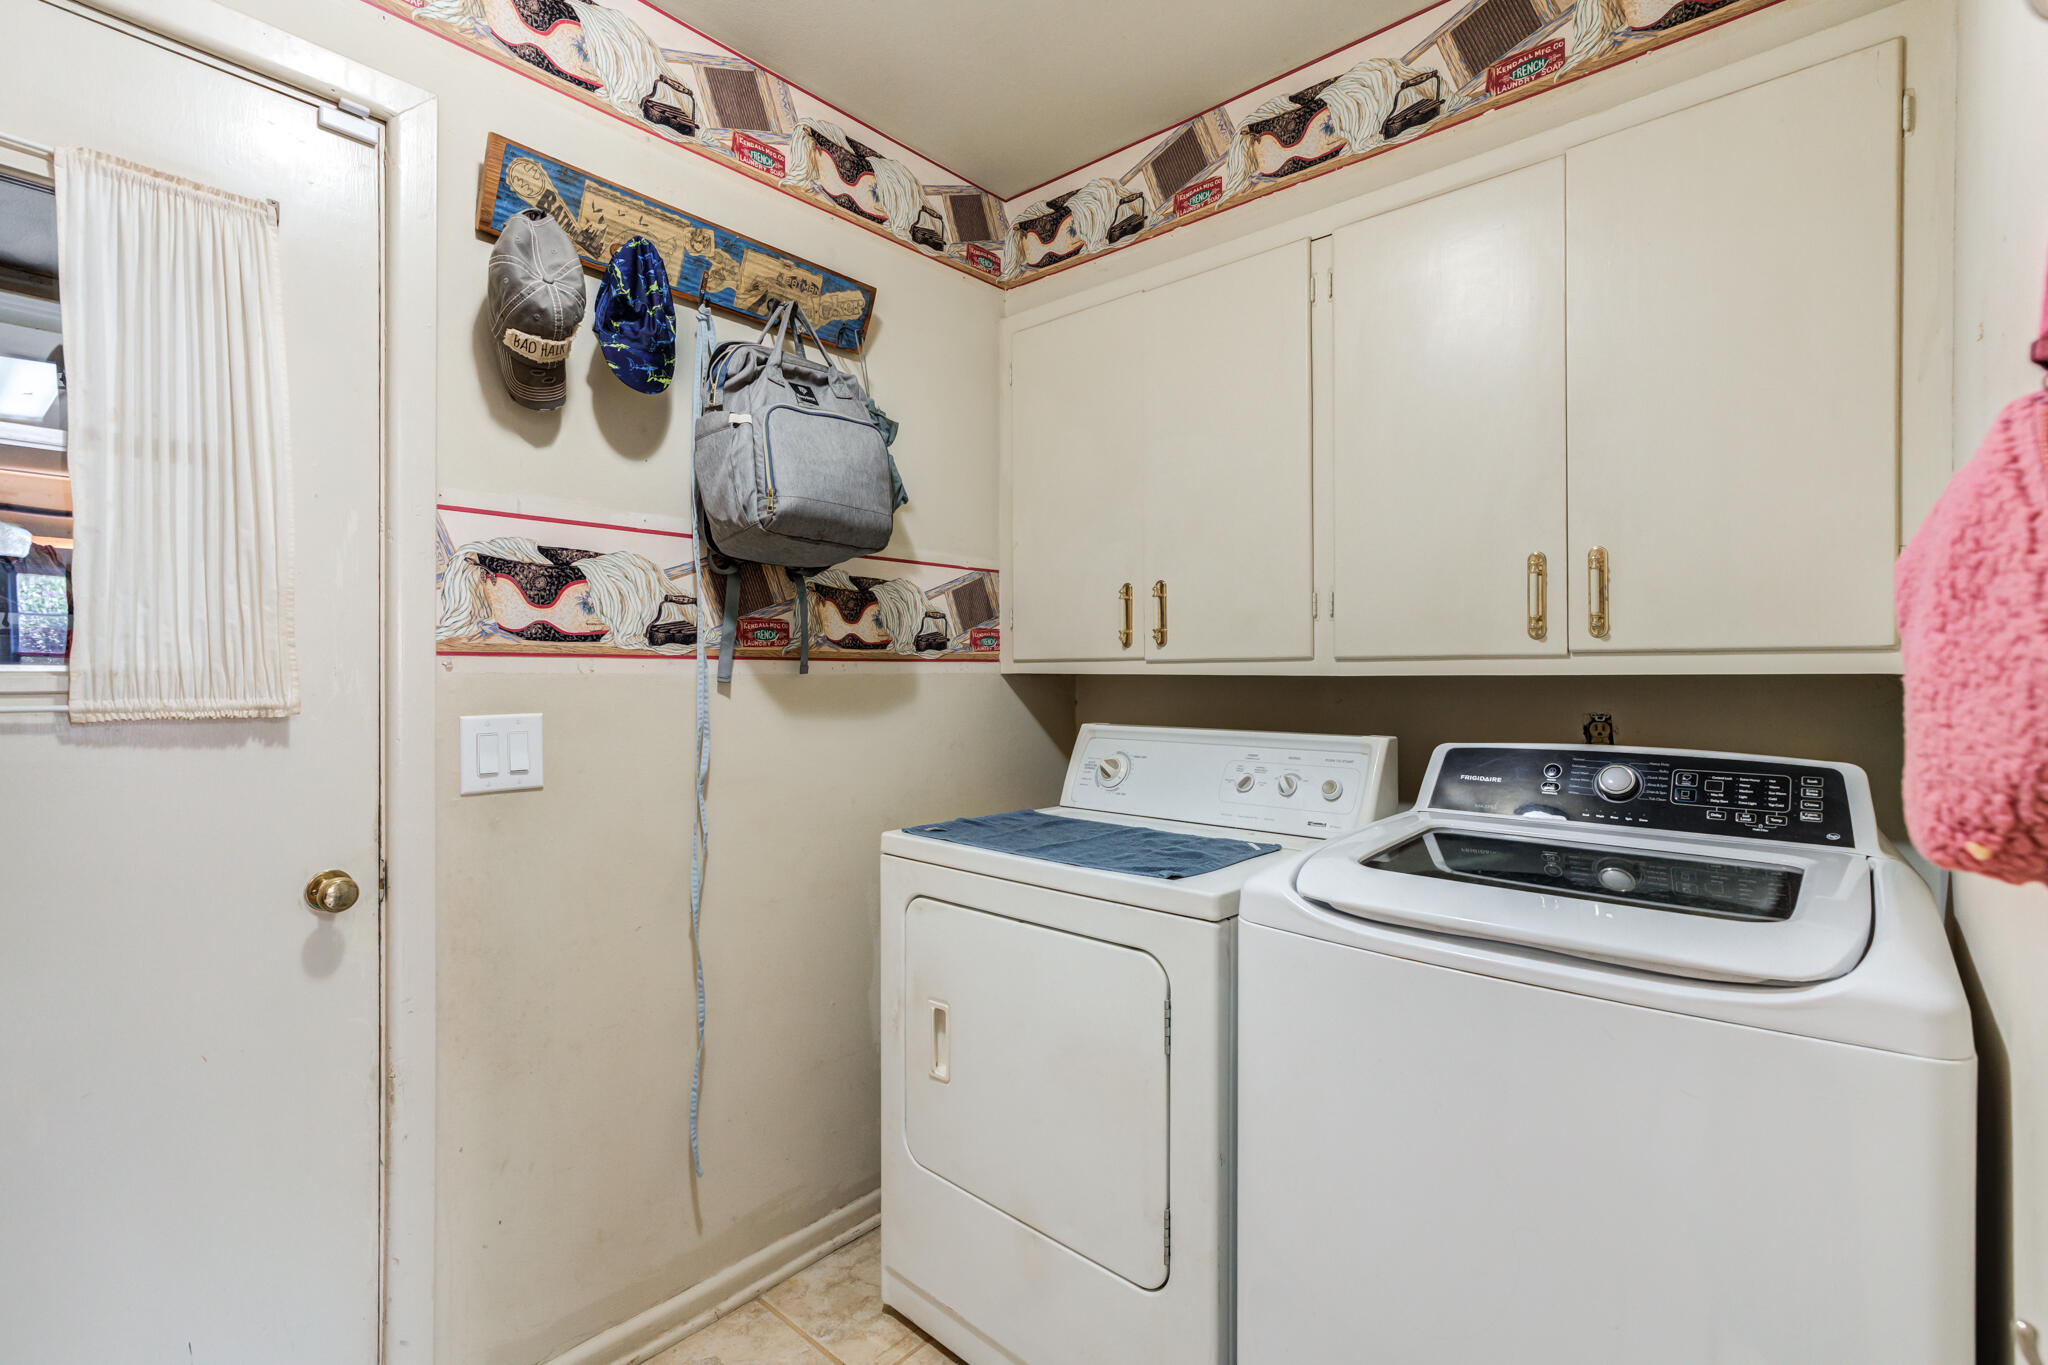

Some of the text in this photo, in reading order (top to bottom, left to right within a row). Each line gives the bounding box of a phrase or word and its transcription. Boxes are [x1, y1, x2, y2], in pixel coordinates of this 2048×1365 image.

[1496, 54, 1534, 75] KENDALL
[1553, 41, 1564, 50] CO
[1512, 58, 1545, 79] FRENCH
[1497, 61, 1564, 94] LAUNDRY SOAP
[740, 136, 765, 151] KENDALL
[740, 155, 785, 178] LAUNDRY SOAP
[751, 150, 773, 167] FRENCH
[1190, 191, 1210, 205] FRENCH
[513, 334, 537, 354] BAD
[743, 622, 769, 630] KENDALL
[755, 629, 776, 640] FRENCH
[1460, 774, 1502, 783] FRIGIDAIRE
